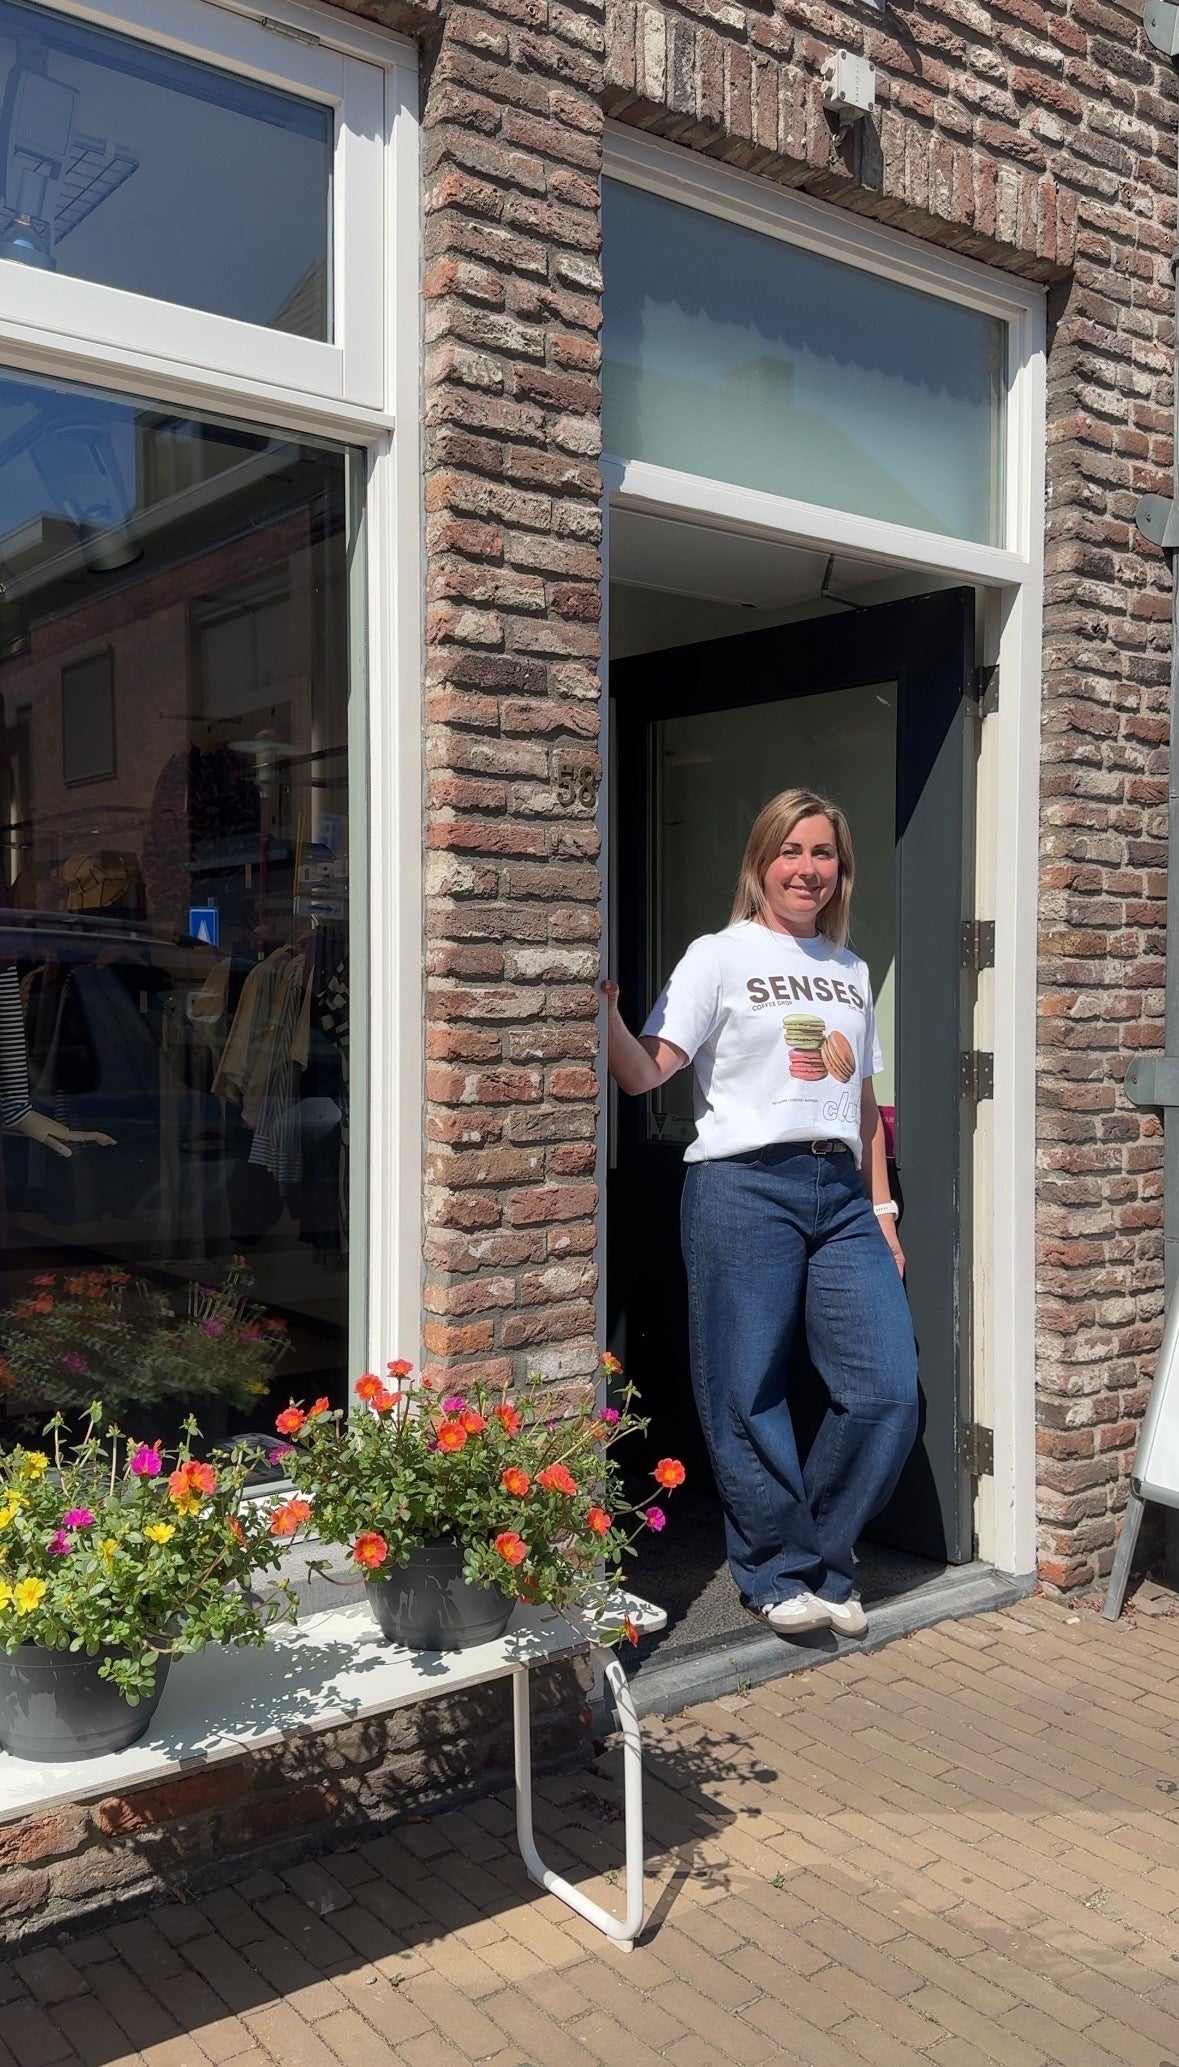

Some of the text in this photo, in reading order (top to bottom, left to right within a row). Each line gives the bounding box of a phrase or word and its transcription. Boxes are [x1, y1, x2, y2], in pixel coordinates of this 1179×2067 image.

[557, 763, 597, 809] 58
[746, 976, 864, 1009] SENSES
[752, 1001, 776, 1012] COFFEE
